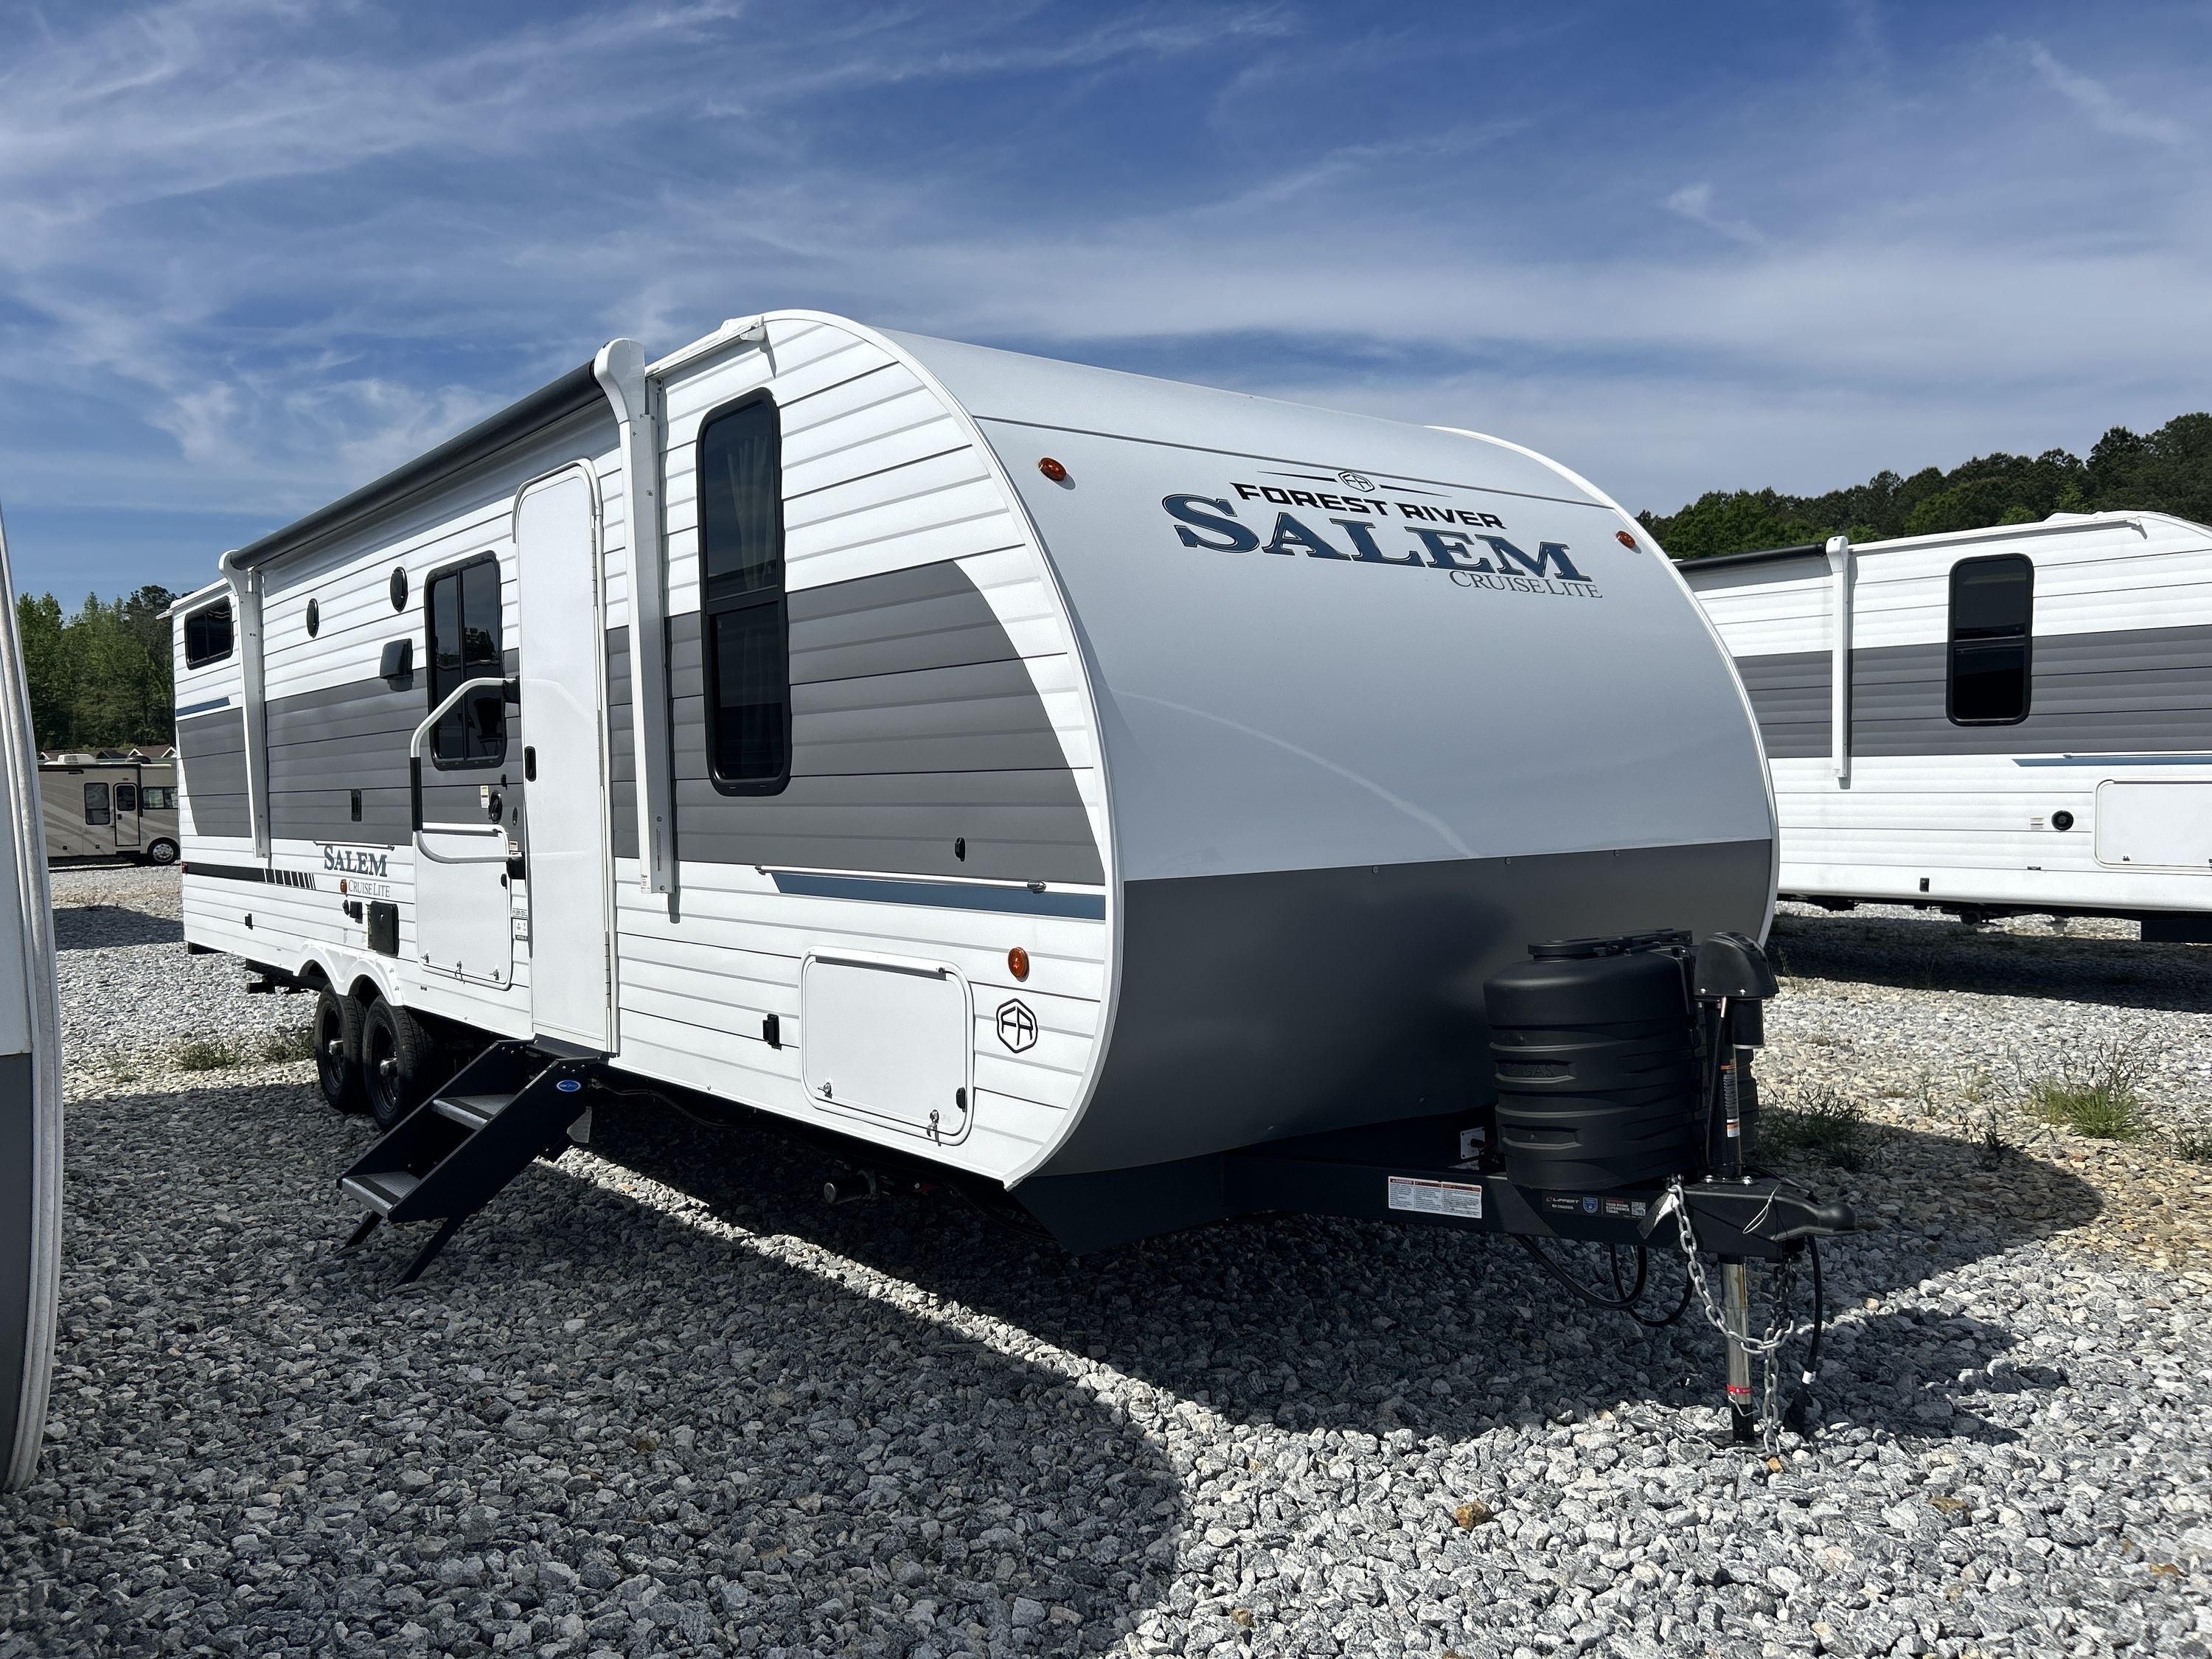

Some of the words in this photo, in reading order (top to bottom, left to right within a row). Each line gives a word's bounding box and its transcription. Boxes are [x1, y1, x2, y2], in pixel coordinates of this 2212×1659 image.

[1229, 482, 1388, 516] FOREST
[1394, 502, 1507, 529] RIVER
[1162, 494, 1593, 582] SALEM
[324, 844, 388, 877] SALEM
[1520, 1063, 1554, 1077] GAS
